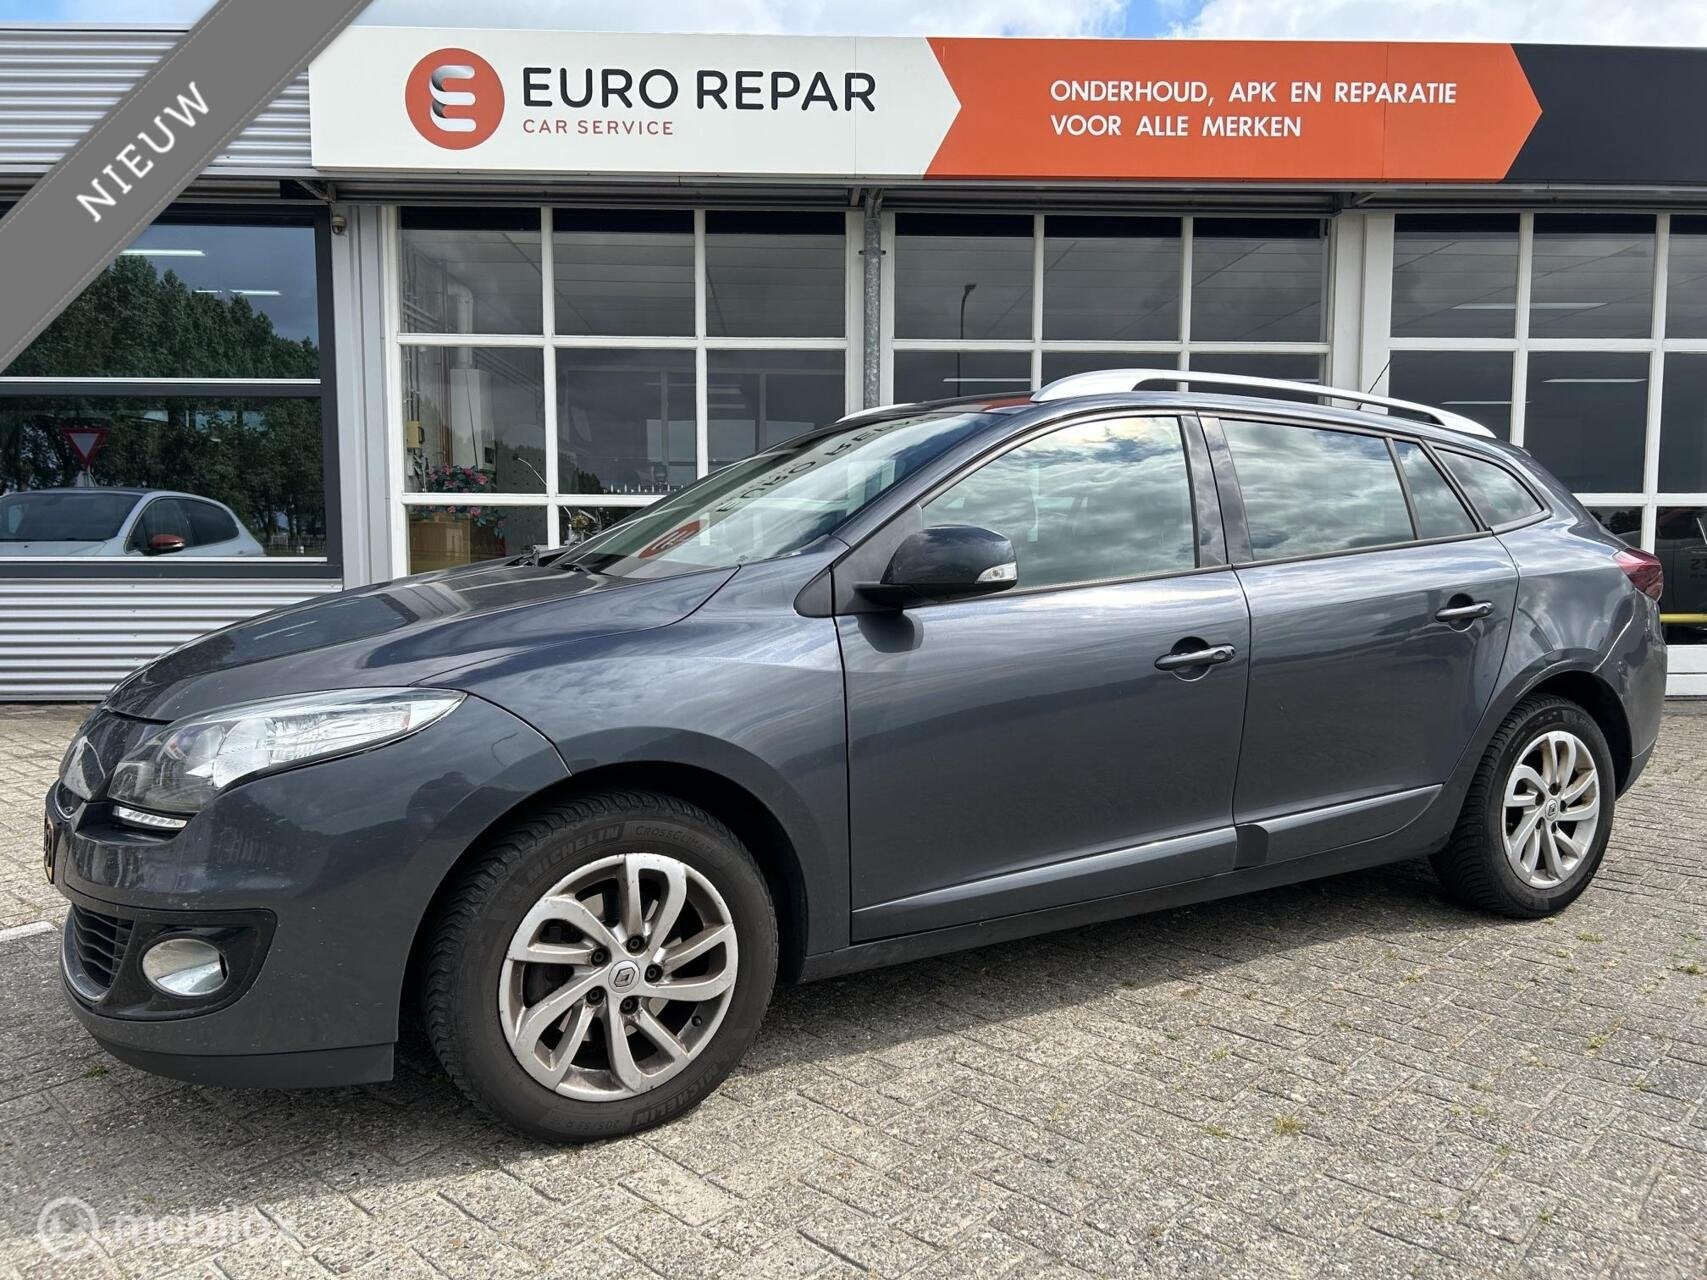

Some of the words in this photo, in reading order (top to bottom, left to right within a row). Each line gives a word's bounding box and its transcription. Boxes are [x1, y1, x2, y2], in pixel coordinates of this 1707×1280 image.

[522, 67, 679, 110] EURO
[696, 69, 876, 112] REPAR
[1050, 79, 1214, 107] ONDERHOUD,
[1228, 81, 1277, 103] APK
[1290, 81, 1322, 103] EN
[1334, 81, 1457, 104] REPARATIE
[522, 118, 568, 134] CAR
[577, 119, 674, 136] SERVICE
[1050, 115, 1122, 137] VOOR
[1135, 115, 1189, 137] ALLE
[1202, 115, 1302, 137] MERKEN
[527, 824, 620, 883] MICHELIN
